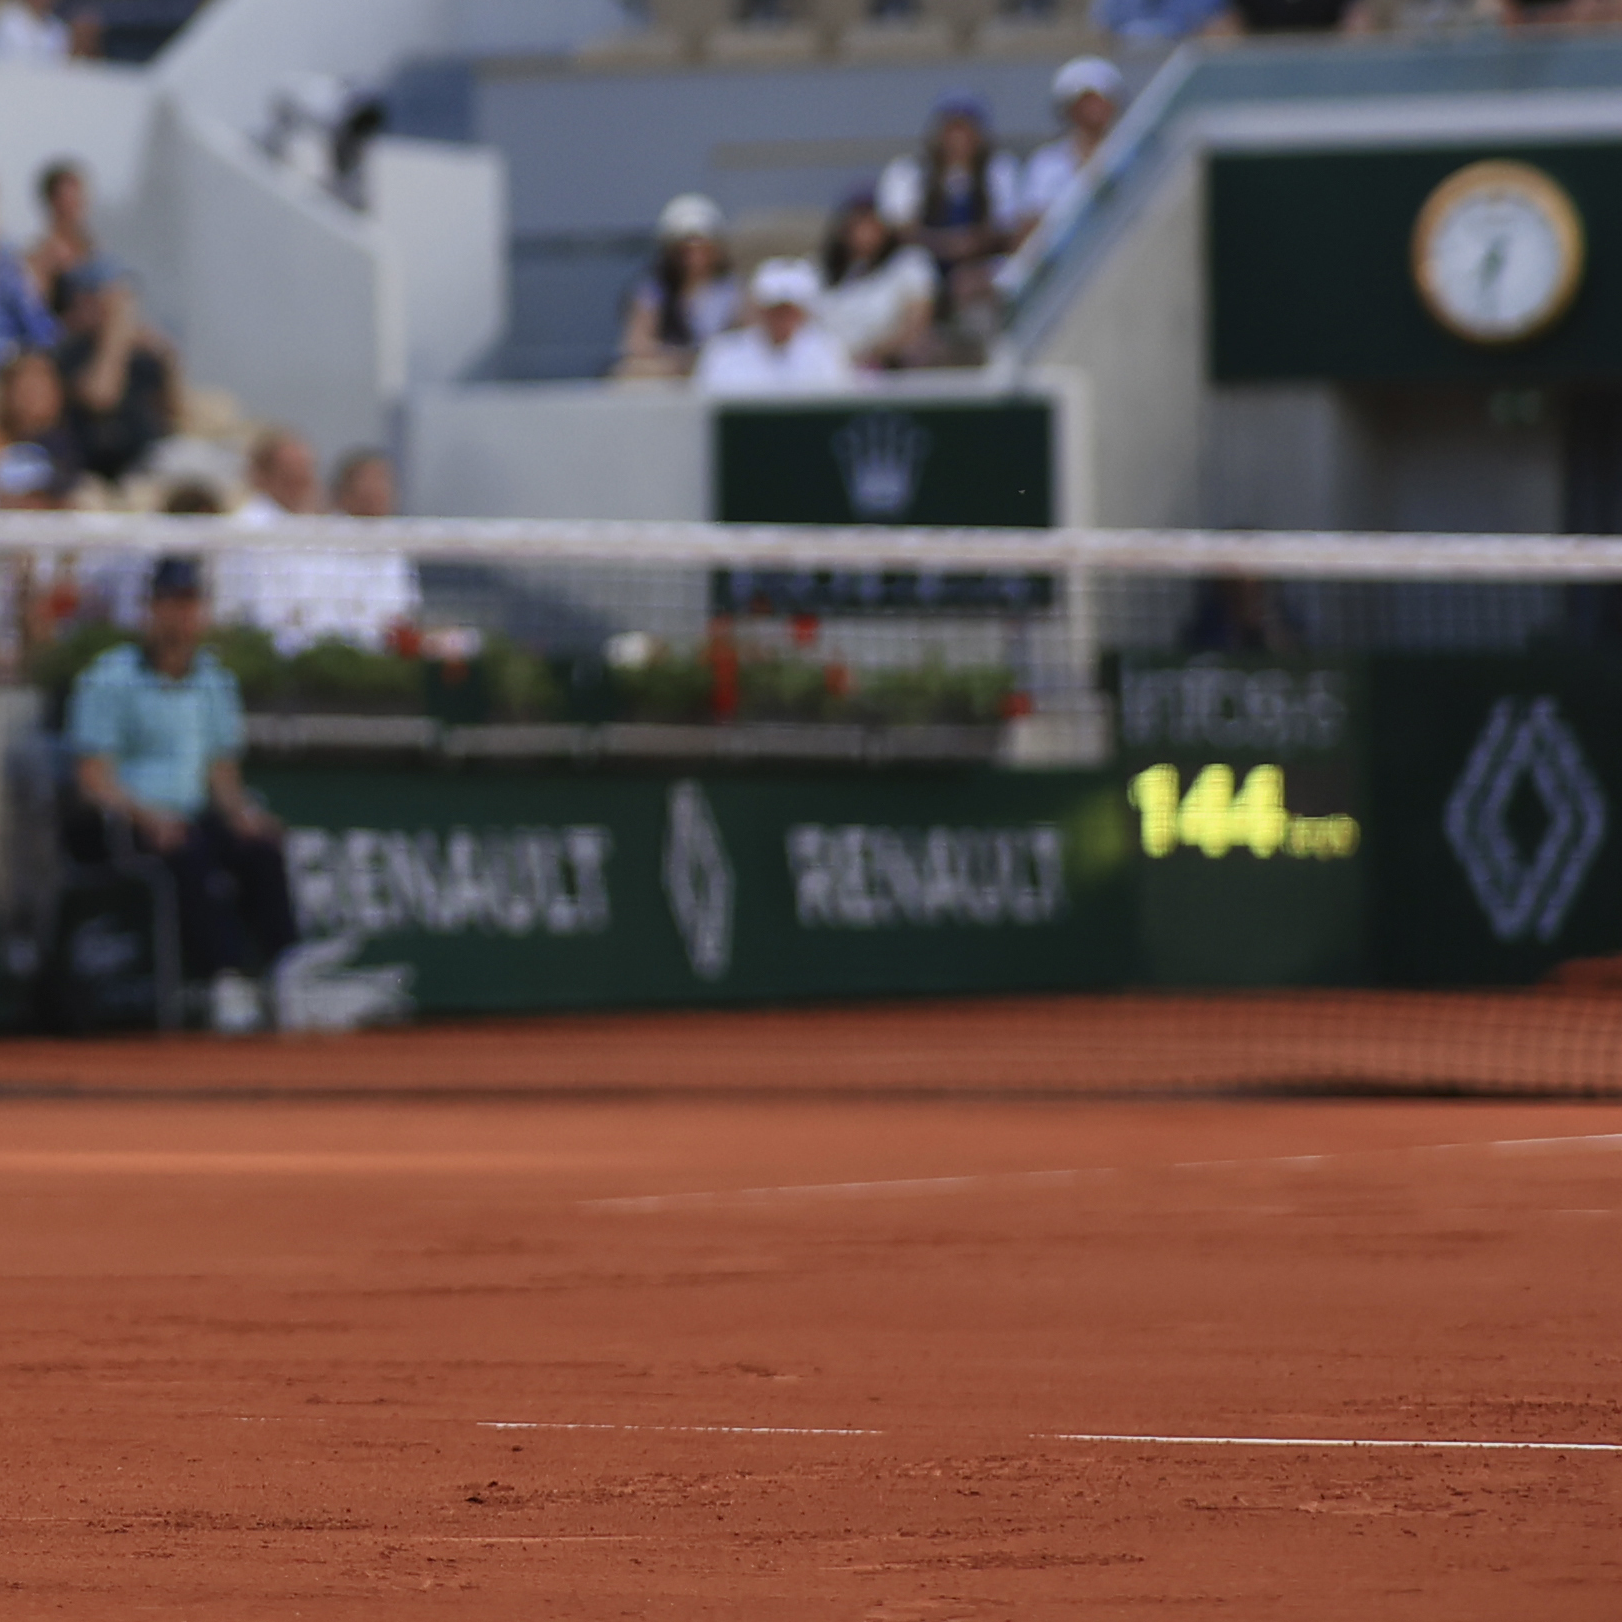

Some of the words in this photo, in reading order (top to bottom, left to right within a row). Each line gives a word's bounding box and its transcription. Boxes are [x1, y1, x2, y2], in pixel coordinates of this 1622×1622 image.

[1128, 763, 1288, 859] 144
[286, 824, 610, 935] RENAULT
[785, 822, 1065, 927] RENAULT
